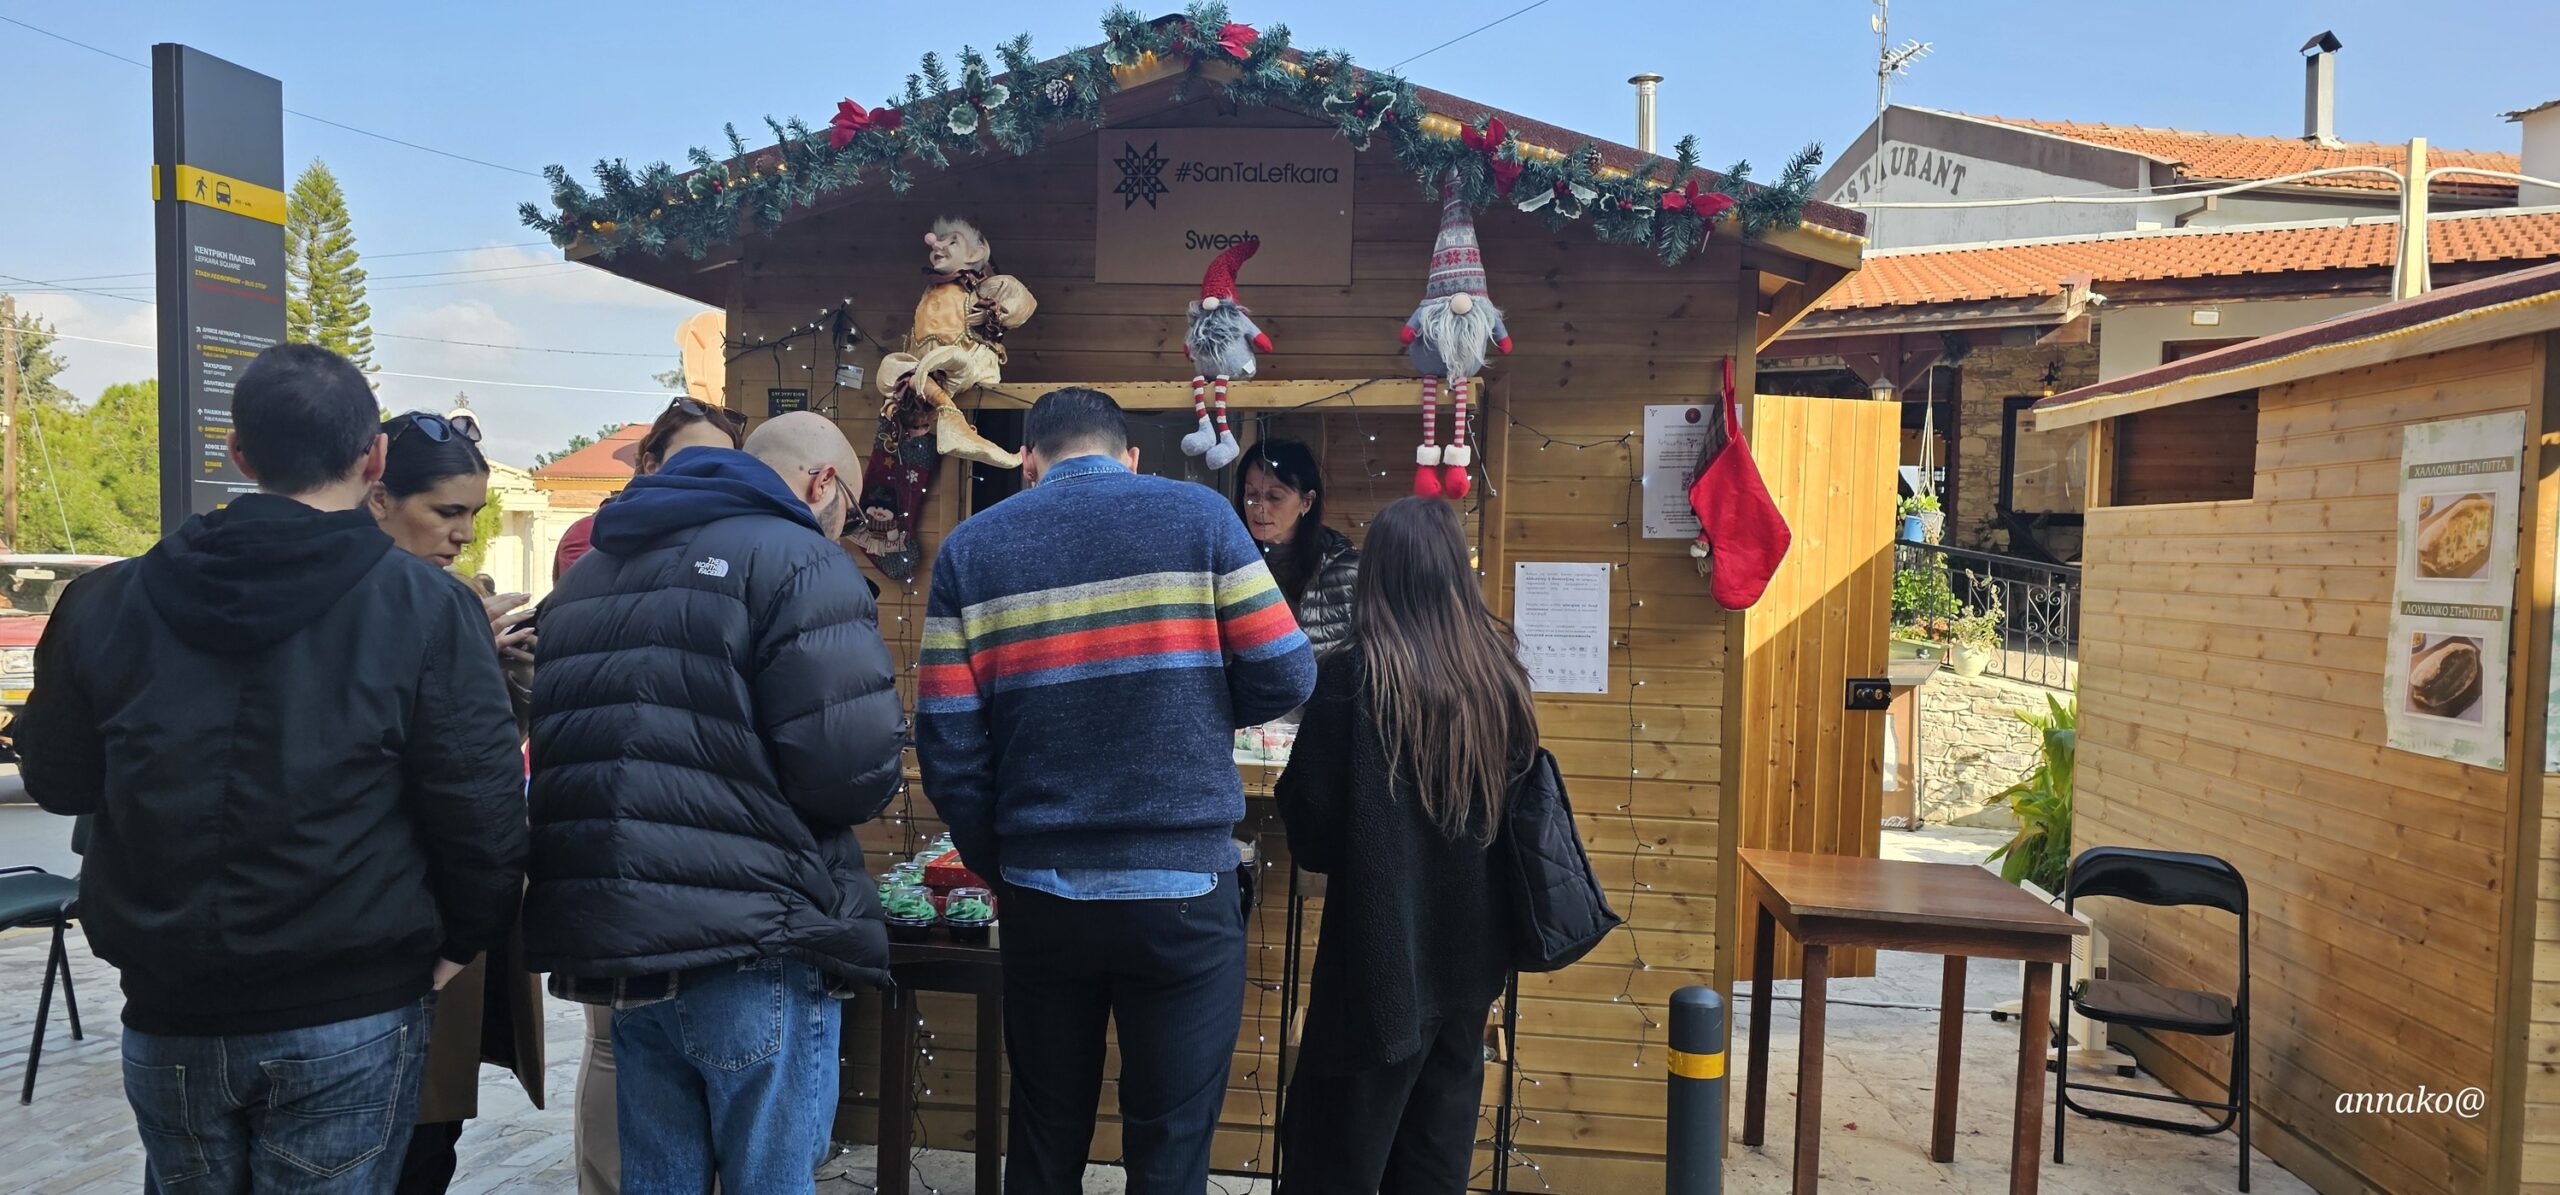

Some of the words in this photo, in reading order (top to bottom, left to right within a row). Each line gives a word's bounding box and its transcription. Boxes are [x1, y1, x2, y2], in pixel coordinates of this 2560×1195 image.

[1174, 161, 1339, 184] #SanTaLefkara
[194, 245, 228, 260] ΚΕΝΤΡΙΚΗ
[229, 253, 256, 266] ΠΛΑΤΕΙΑ
[195, 255, 219, 265] LEFKARA
[220, 260, 240, 270] SQUARE
[2414, 464, 2457, 477] ΧΑΛΛΟΥΜΙ
[2459, 462, 2480, 474] ΣΤΗΝ
[2481, 460, 2508, 472] ΠΙΤΤΑ
[2405, 604, 2449, 616] ΛΟΥΚΑΝΙΚΟ
[2449, 606, 2471, 618] ΣΤΗΝ
[2472, 607, 2498, 619] ΠΙΤΤΑ
